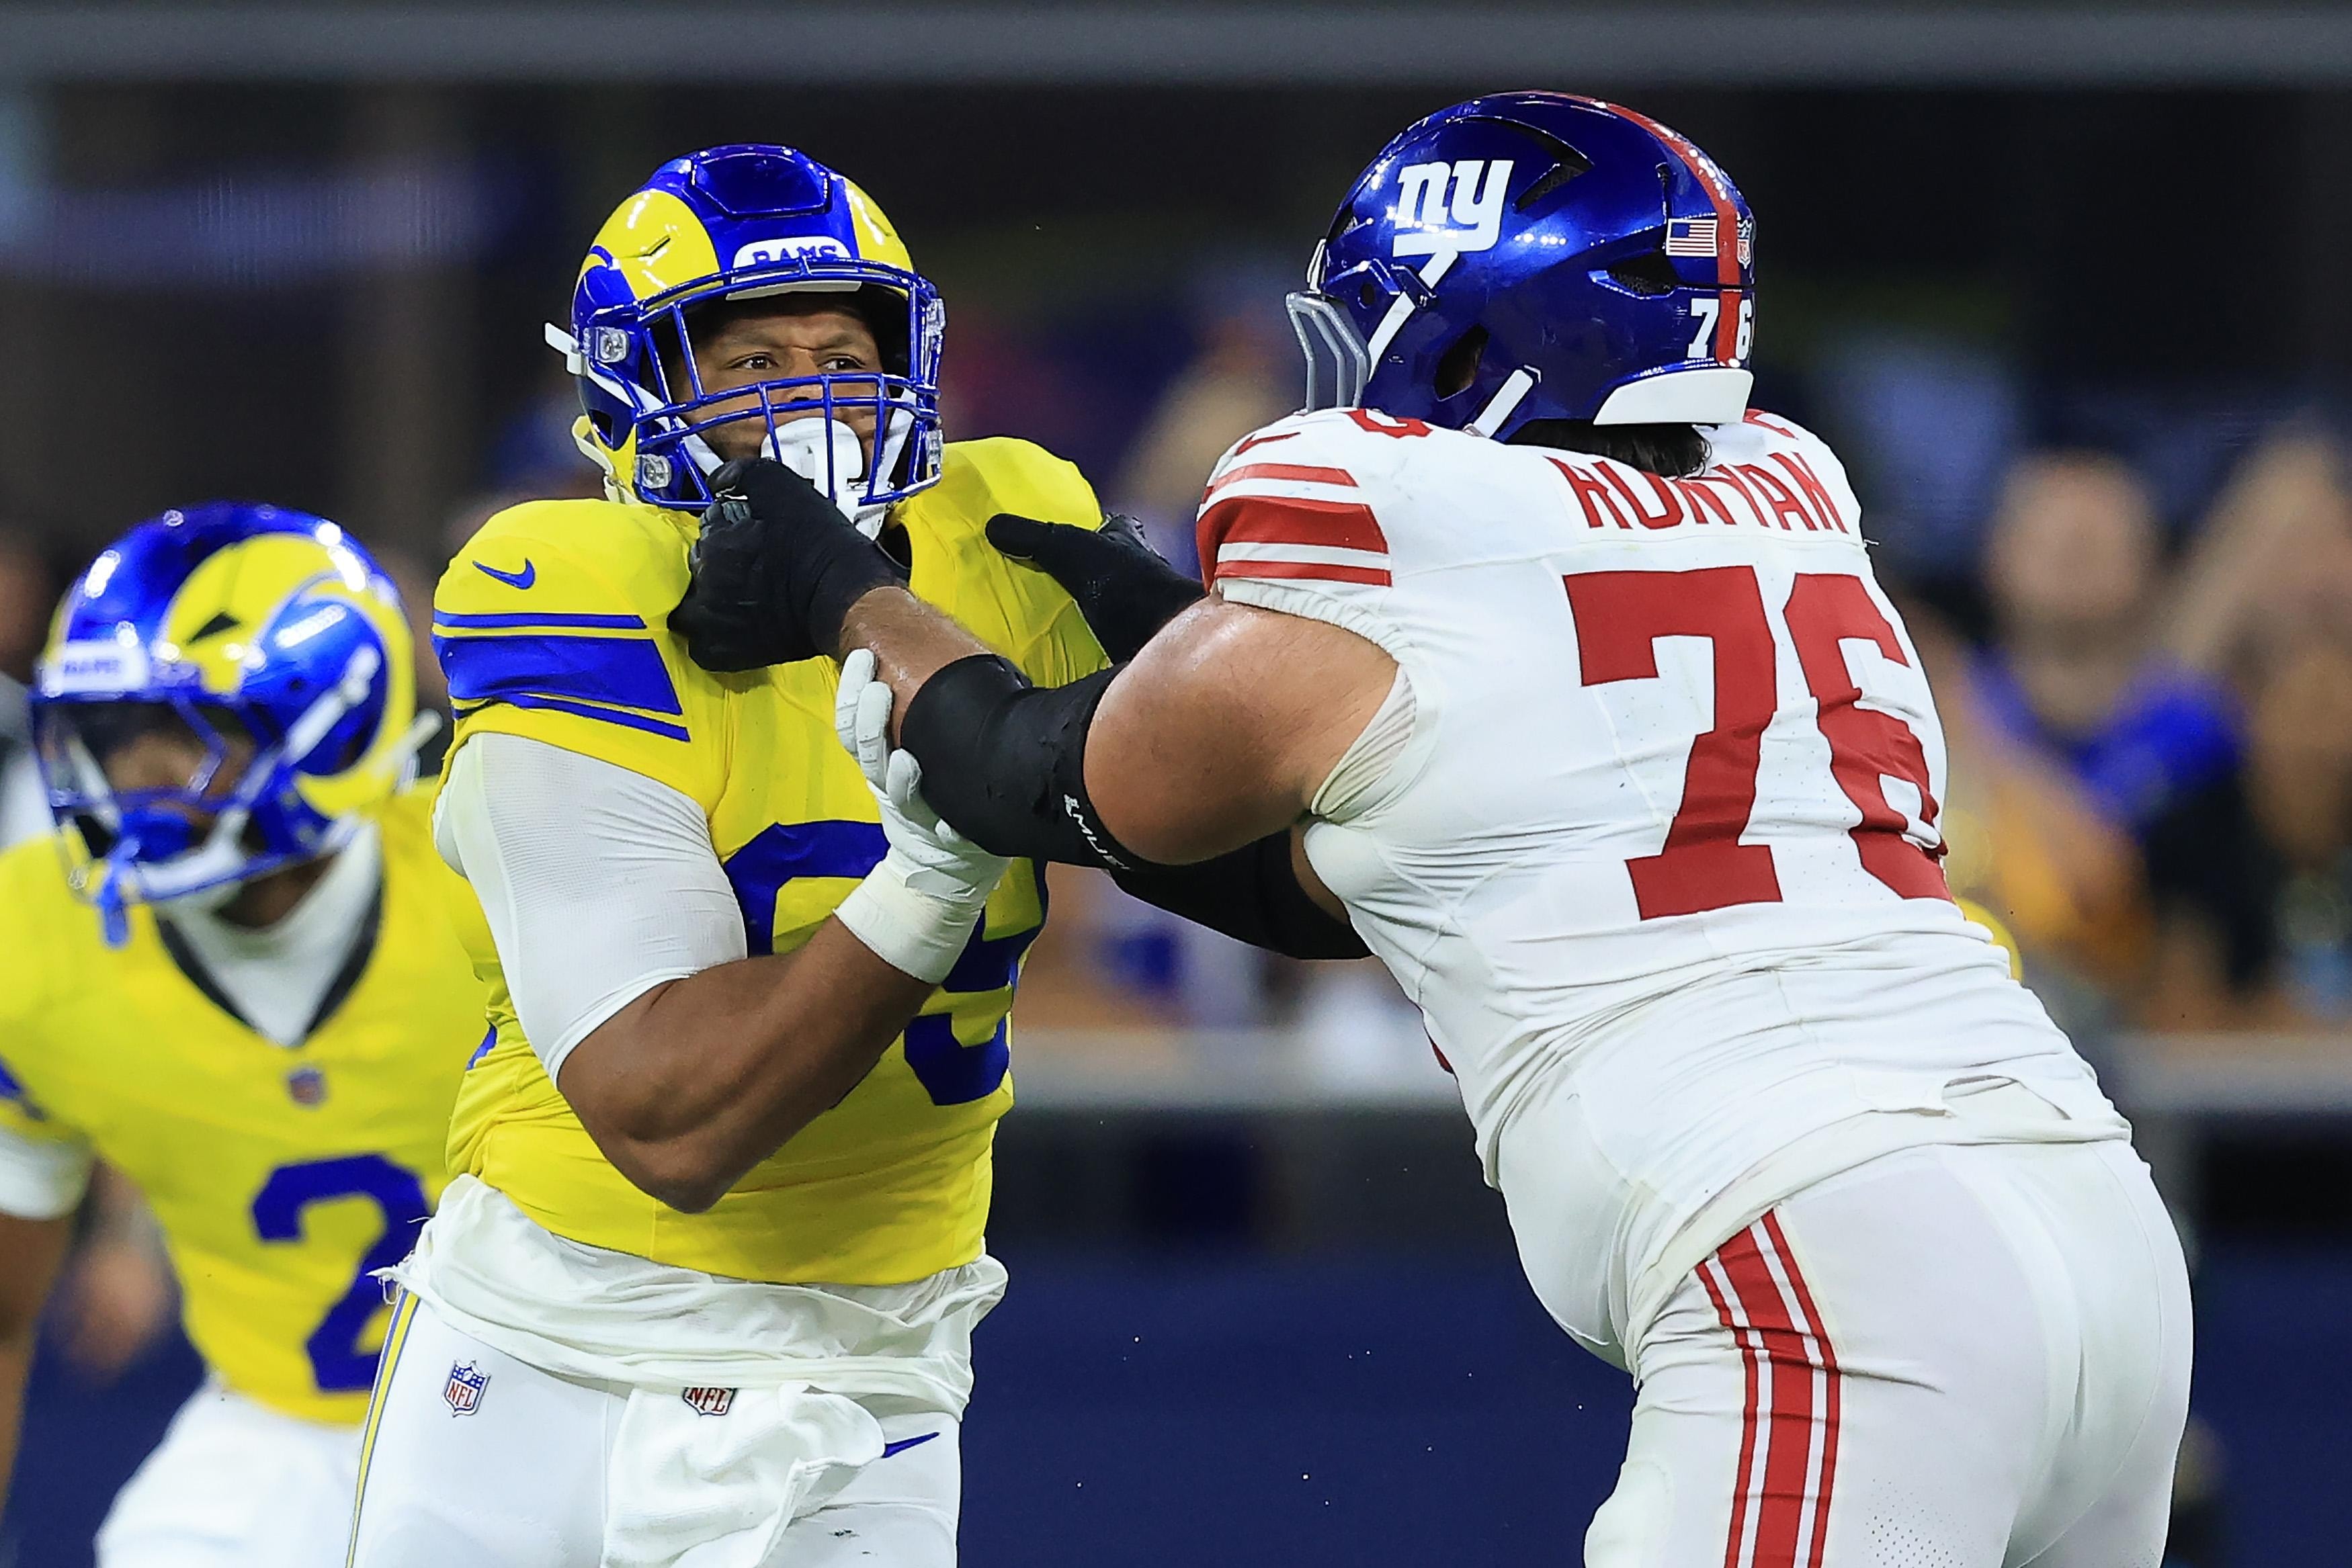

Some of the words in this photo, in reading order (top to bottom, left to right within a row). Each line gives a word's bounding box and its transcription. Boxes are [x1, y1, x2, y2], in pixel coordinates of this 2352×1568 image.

[1687, 298, 1753, 360] 76
[1562, 565, 1954, 921] 76
[448, 1381, 474, 1407] NFL
[686, 1387, 726, 1412] NFL
